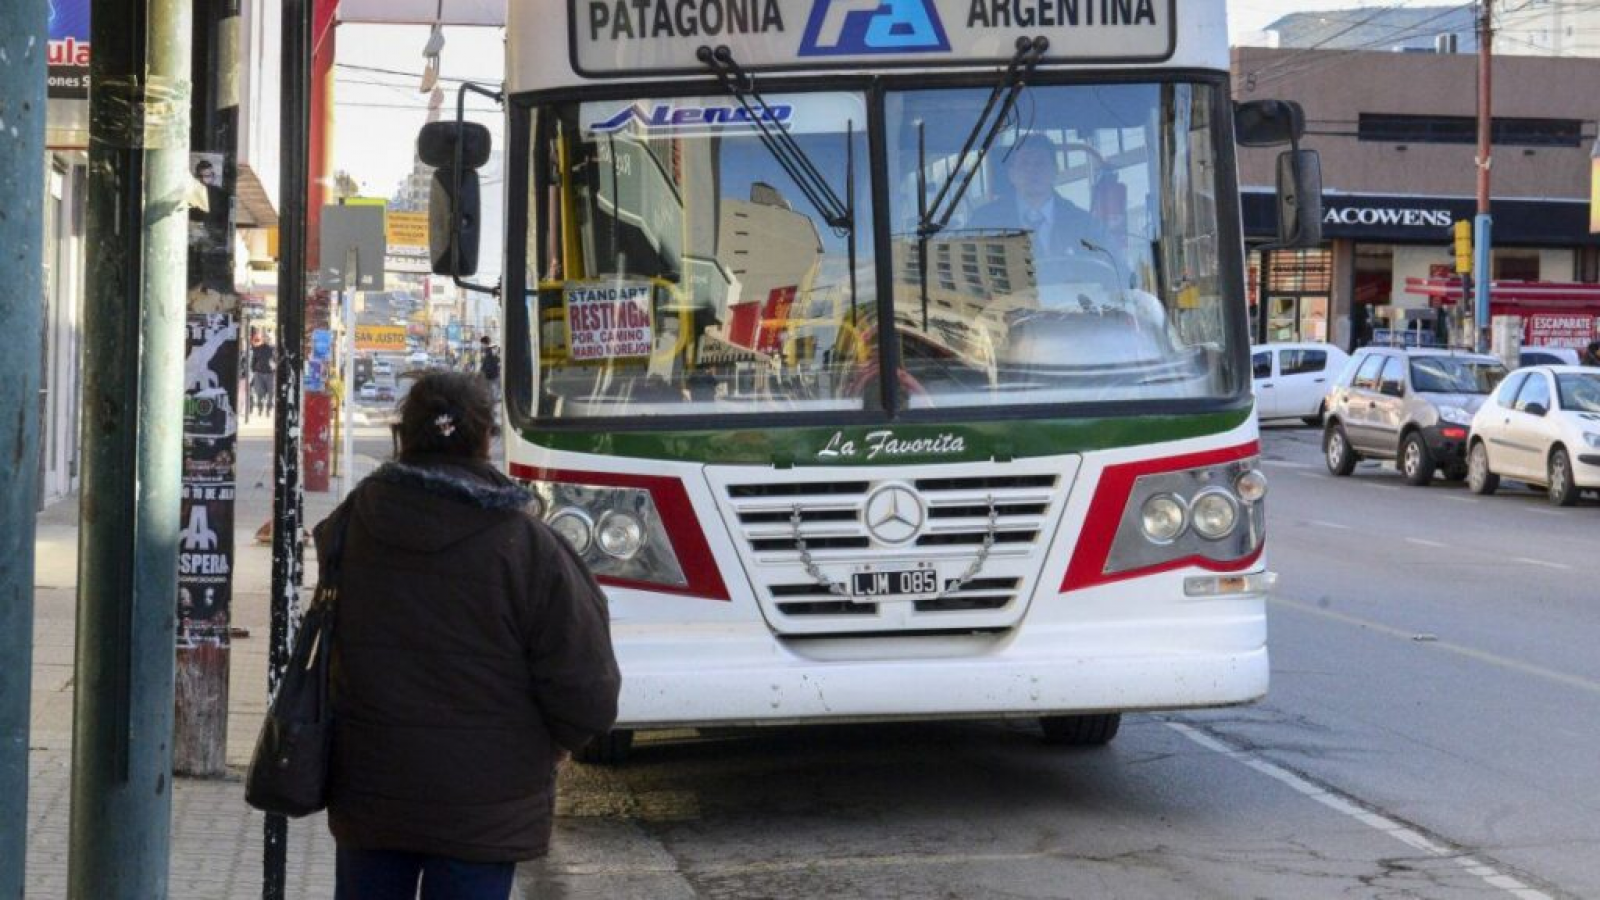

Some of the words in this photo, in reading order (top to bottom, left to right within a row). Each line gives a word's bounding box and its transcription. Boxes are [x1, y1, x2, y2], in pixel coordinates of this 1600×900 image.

[589, 0, 784, 41] PATAGONIA
[966, 0, 1156, 28] ARGENTINA
[1322, 206, 1452, 226] ACOWENS
[819, 431, 855, 456] La
[866, 430, 965, 459] Favorita
[179, 553, 230, 574] SPERA
[853, 573, 891, 596] LJM
[900, 570, 936, 593] 085
